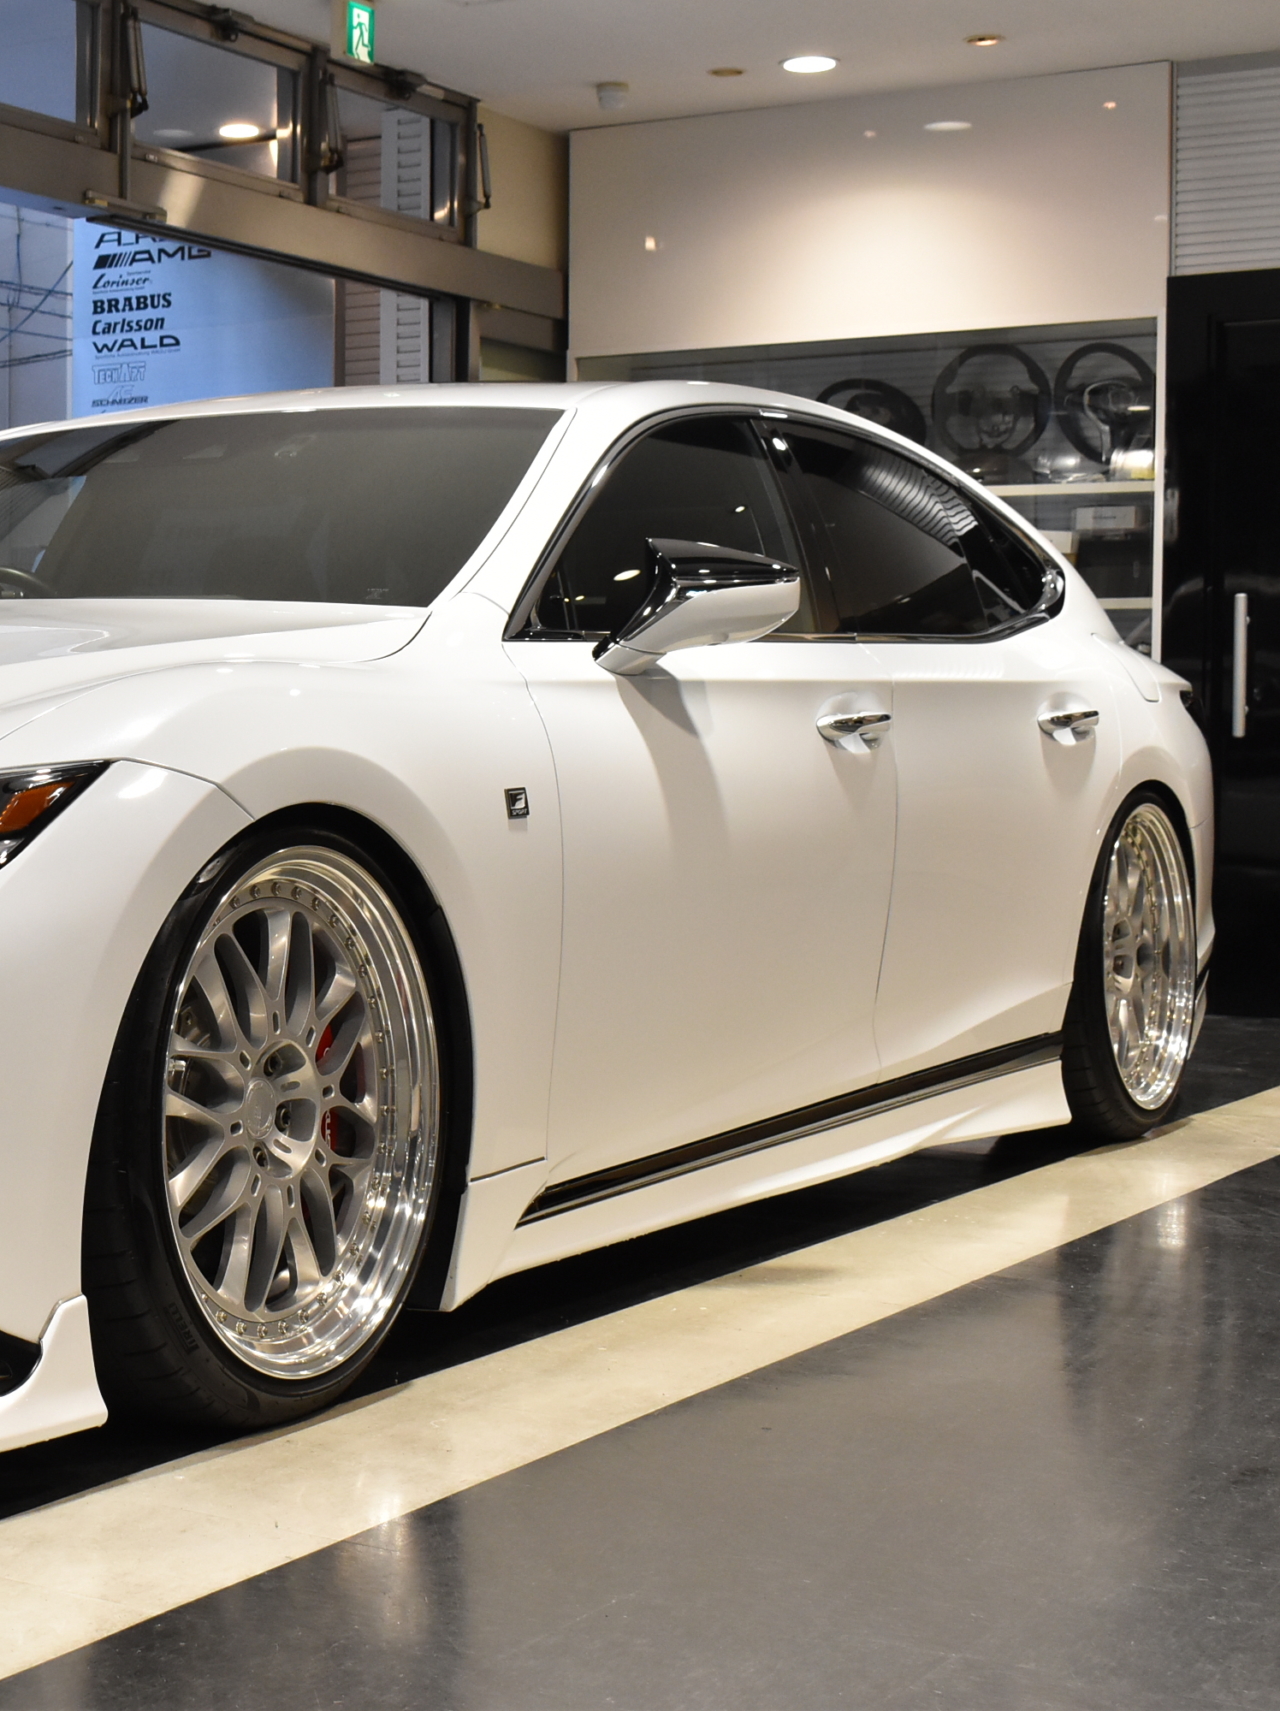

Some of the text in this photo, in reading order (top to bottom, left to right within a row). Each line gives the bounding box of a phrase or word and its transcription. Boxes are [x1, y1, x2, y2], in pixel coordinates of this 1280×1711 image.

[128, 245, 212, 266] AMG
[92, 273, 150, 289] Lorinser
[92, 292, 172, 315] BRABUS
[92, 317, 165, 336] Carlsson
[92, 334, 181, 354] WALD
